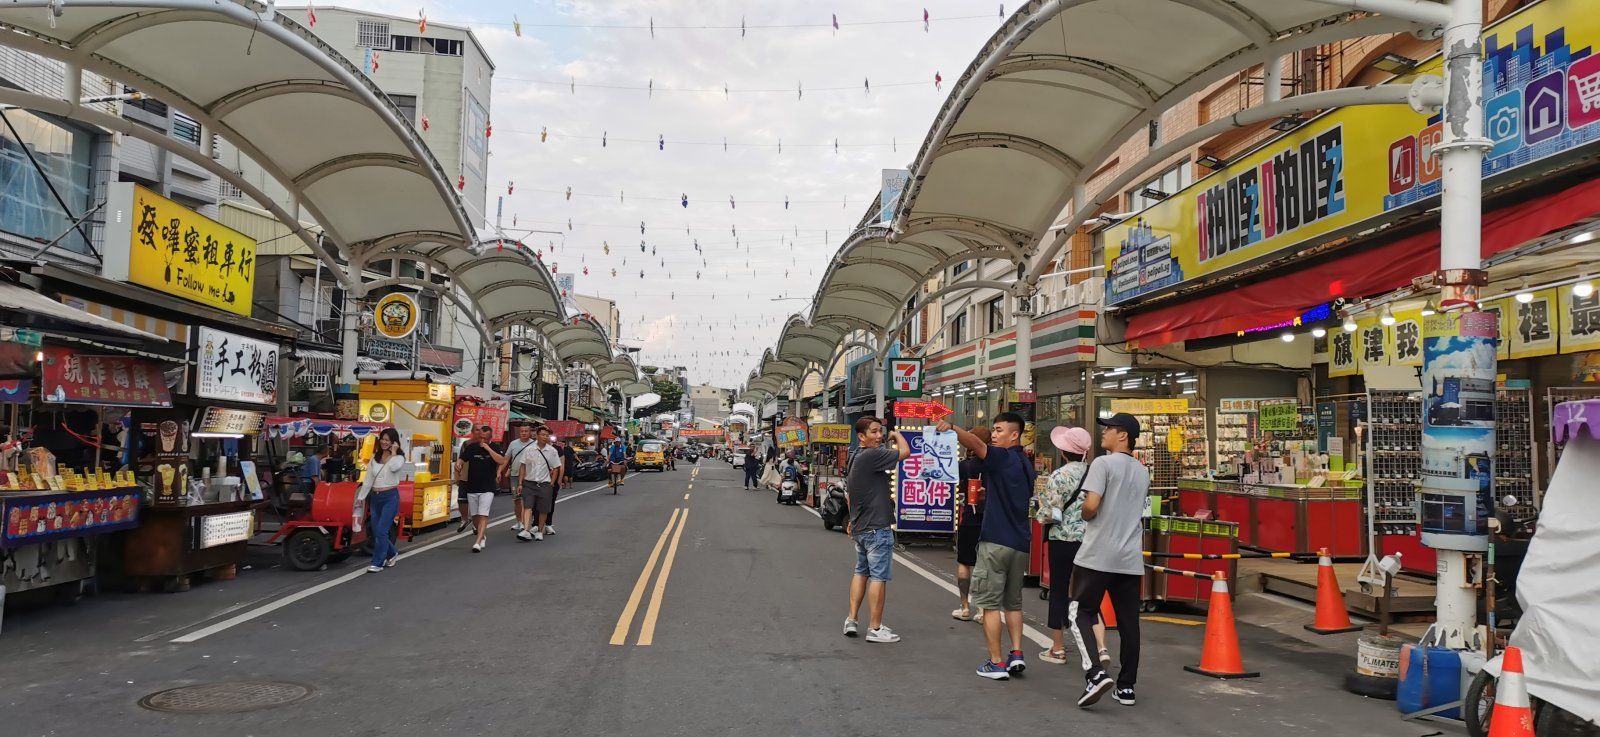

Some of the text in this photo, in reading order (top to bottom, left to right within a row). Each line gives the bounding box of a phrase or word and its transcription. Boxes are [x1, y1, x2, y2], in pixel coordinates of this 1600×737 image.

[176, 267, 221, 298] Follow me
[902, 479, 951, 507] 配件
